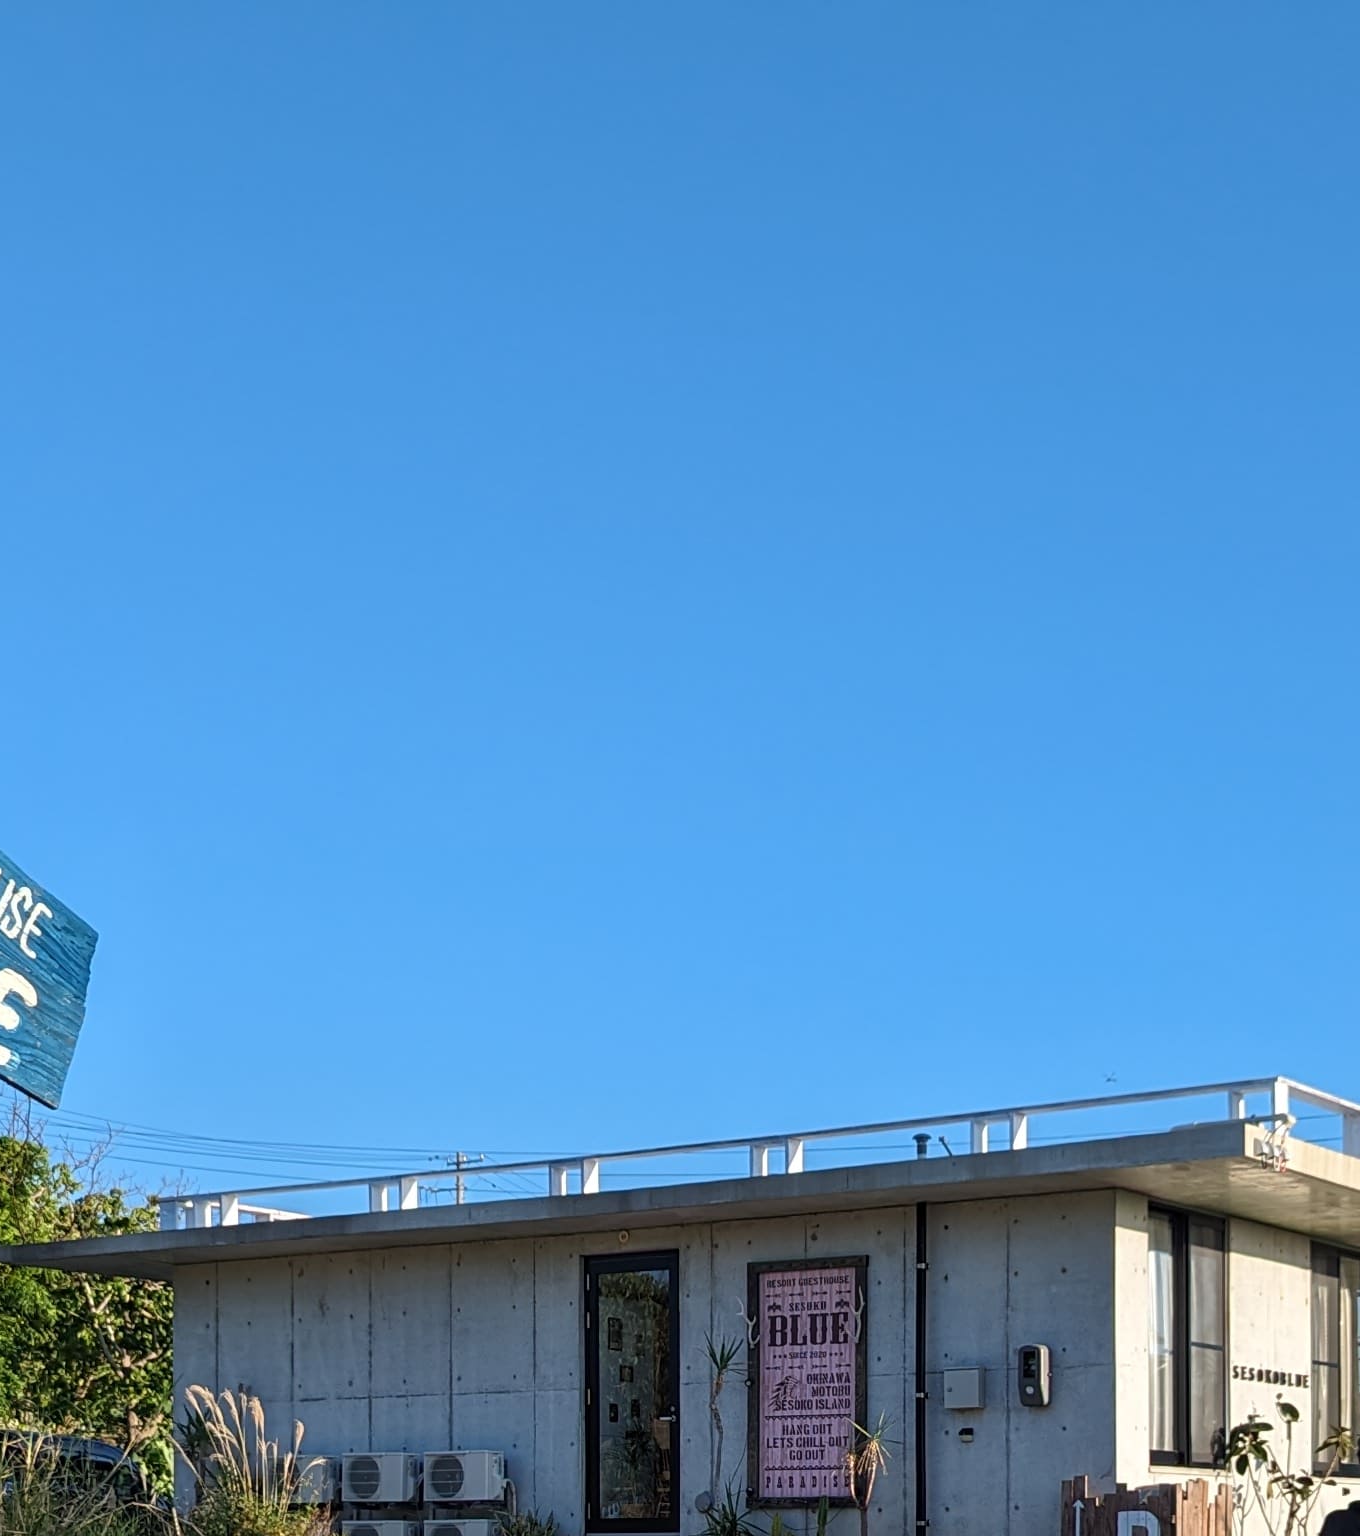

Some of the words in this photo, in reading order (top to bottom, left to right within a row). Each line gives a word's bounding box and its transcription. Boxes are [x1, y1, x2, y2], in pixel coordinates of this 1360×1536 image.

[766, 1278, 796, 1288] RESORT
[798, 1275, 850, 1287] GUESTHOUSE
[788, 1301, 827, 1312] SESOKO
[767, 1312, 849, 1347] BLUE
[809, 1351, 827, 1359] 2020
[806, 1372, 851, 1385] OKINAWA
[811, 1385, 851, 1398] MOTOBU
[774, 1399, 813, 1412] SESOKO
[815, 1398, 851, 1410] ISLAND
[782, 1424, 810, 1436] HANG
[812, 1423, 833, 1435] OUT
[766, 1437, 793, 1448] LETS
[789, 1450, 802, 1460] GO
[805, 1449, 825, 1460] OUT
[766, 1475, 851, 1489] PARADISE
